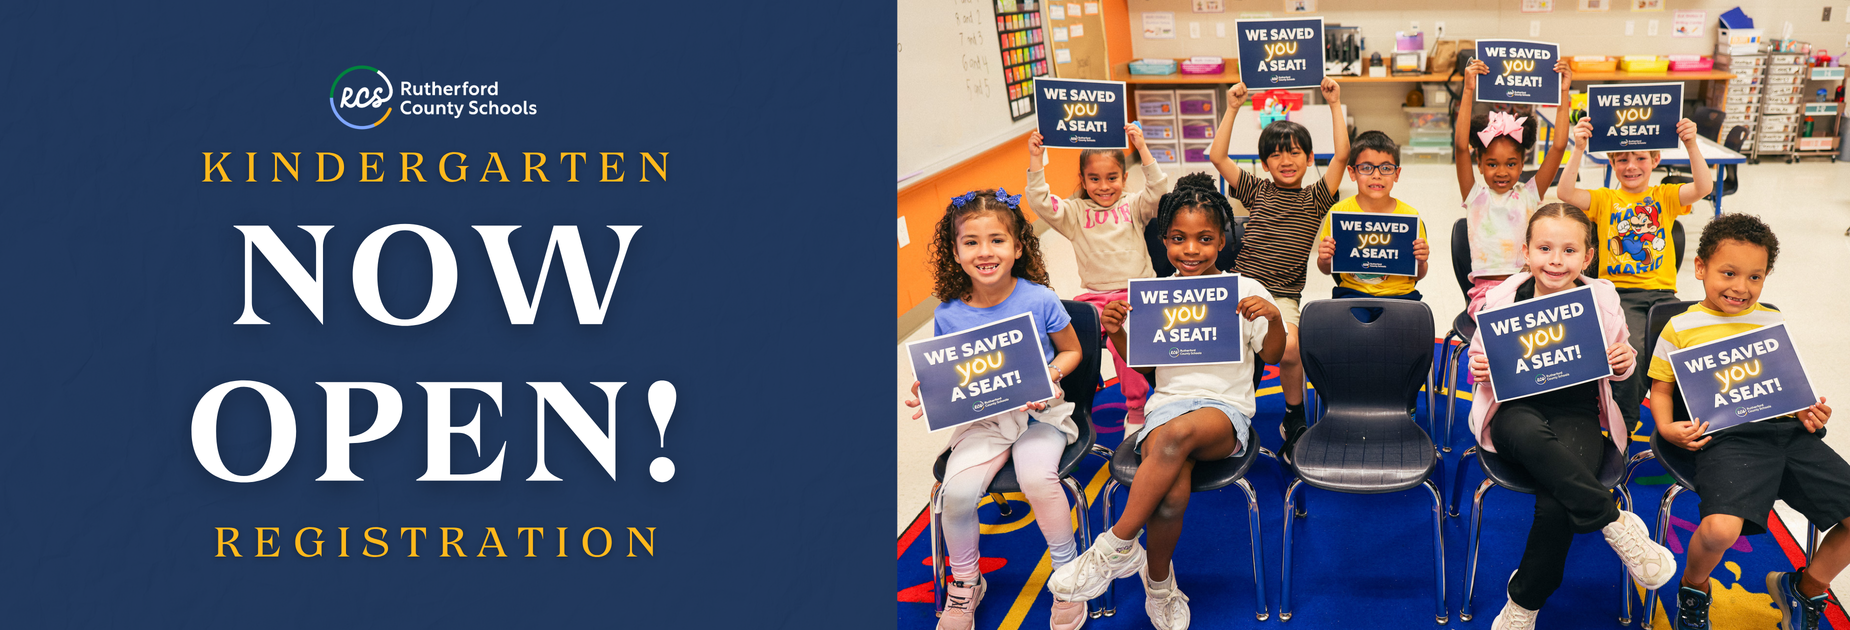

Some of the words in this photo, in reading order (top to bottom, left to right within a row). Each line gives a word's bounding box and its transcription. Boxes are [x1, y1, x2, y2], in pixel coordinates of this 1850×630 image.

[963, 11, 973, 23] and
[1245, 29, 1268, 41] WE
[1270, 28, 1314, 40] SAVED
[1485, 47, 1507, 57] WE
[1509, 48, 1551, 60] SAVED
[962, 54, 968, 71] 6
[969, 55, 981, 69] and
[982, 56, 989, 74] 4
[1258, 61, 1268, 72] A
[1270, 59, 1306, 71] SEAT!
[984, 78, 990, 98] 5
[1494, 75, 1505, 85] A
[1507, 75, 1542, 87] SEAT!
[1044, 88, 1067, 100] WE
[1070, 89, 1116, 102] SAVED
[1597, 95, 1620, 106] WE
[1623, 93, 1672, 106] SAVED
[1056, 120, 1067, 131] A
[1069, 120, 1107, 132] SEAT!
[1606, 126, 1618, 136] A
[1620, 125, 1660, 136] SEAT!
[1340, 220, 1362, 231] WE
[1365, 221, 1409, 233] SAVED
[1350, 248, 1360, 257] A
[1362, 248, 1399, 259] SEAT!
[1607, 255, 1663, 275] MARIO
[1140, 290, 1169, 304] WE
[1173, 287, 1228, 304] SAVED
[1490, 317, 1522, 336] WE
[1525, 302, 1584, 328] SAVED
[1153, 329, 1166, 343] A
[1170, 327, 1217, 342] SEAT!
[924, 347, 959, 365] WE
[961, 329, 1023, 357] SAVED
[1516, 359, 1530, 374] A
[1531, 345, 1581, 370] SEAT!
[1684, 355, 1717, 374] WE
[1718, 338, 1779, 365] SAVED
[951, 386, 966, 402] A
[968, 370, 1022, 397] SEAT!
[1714, 393, 1729, 408] A
[1729, 378, 1782, 403] SEAT!
